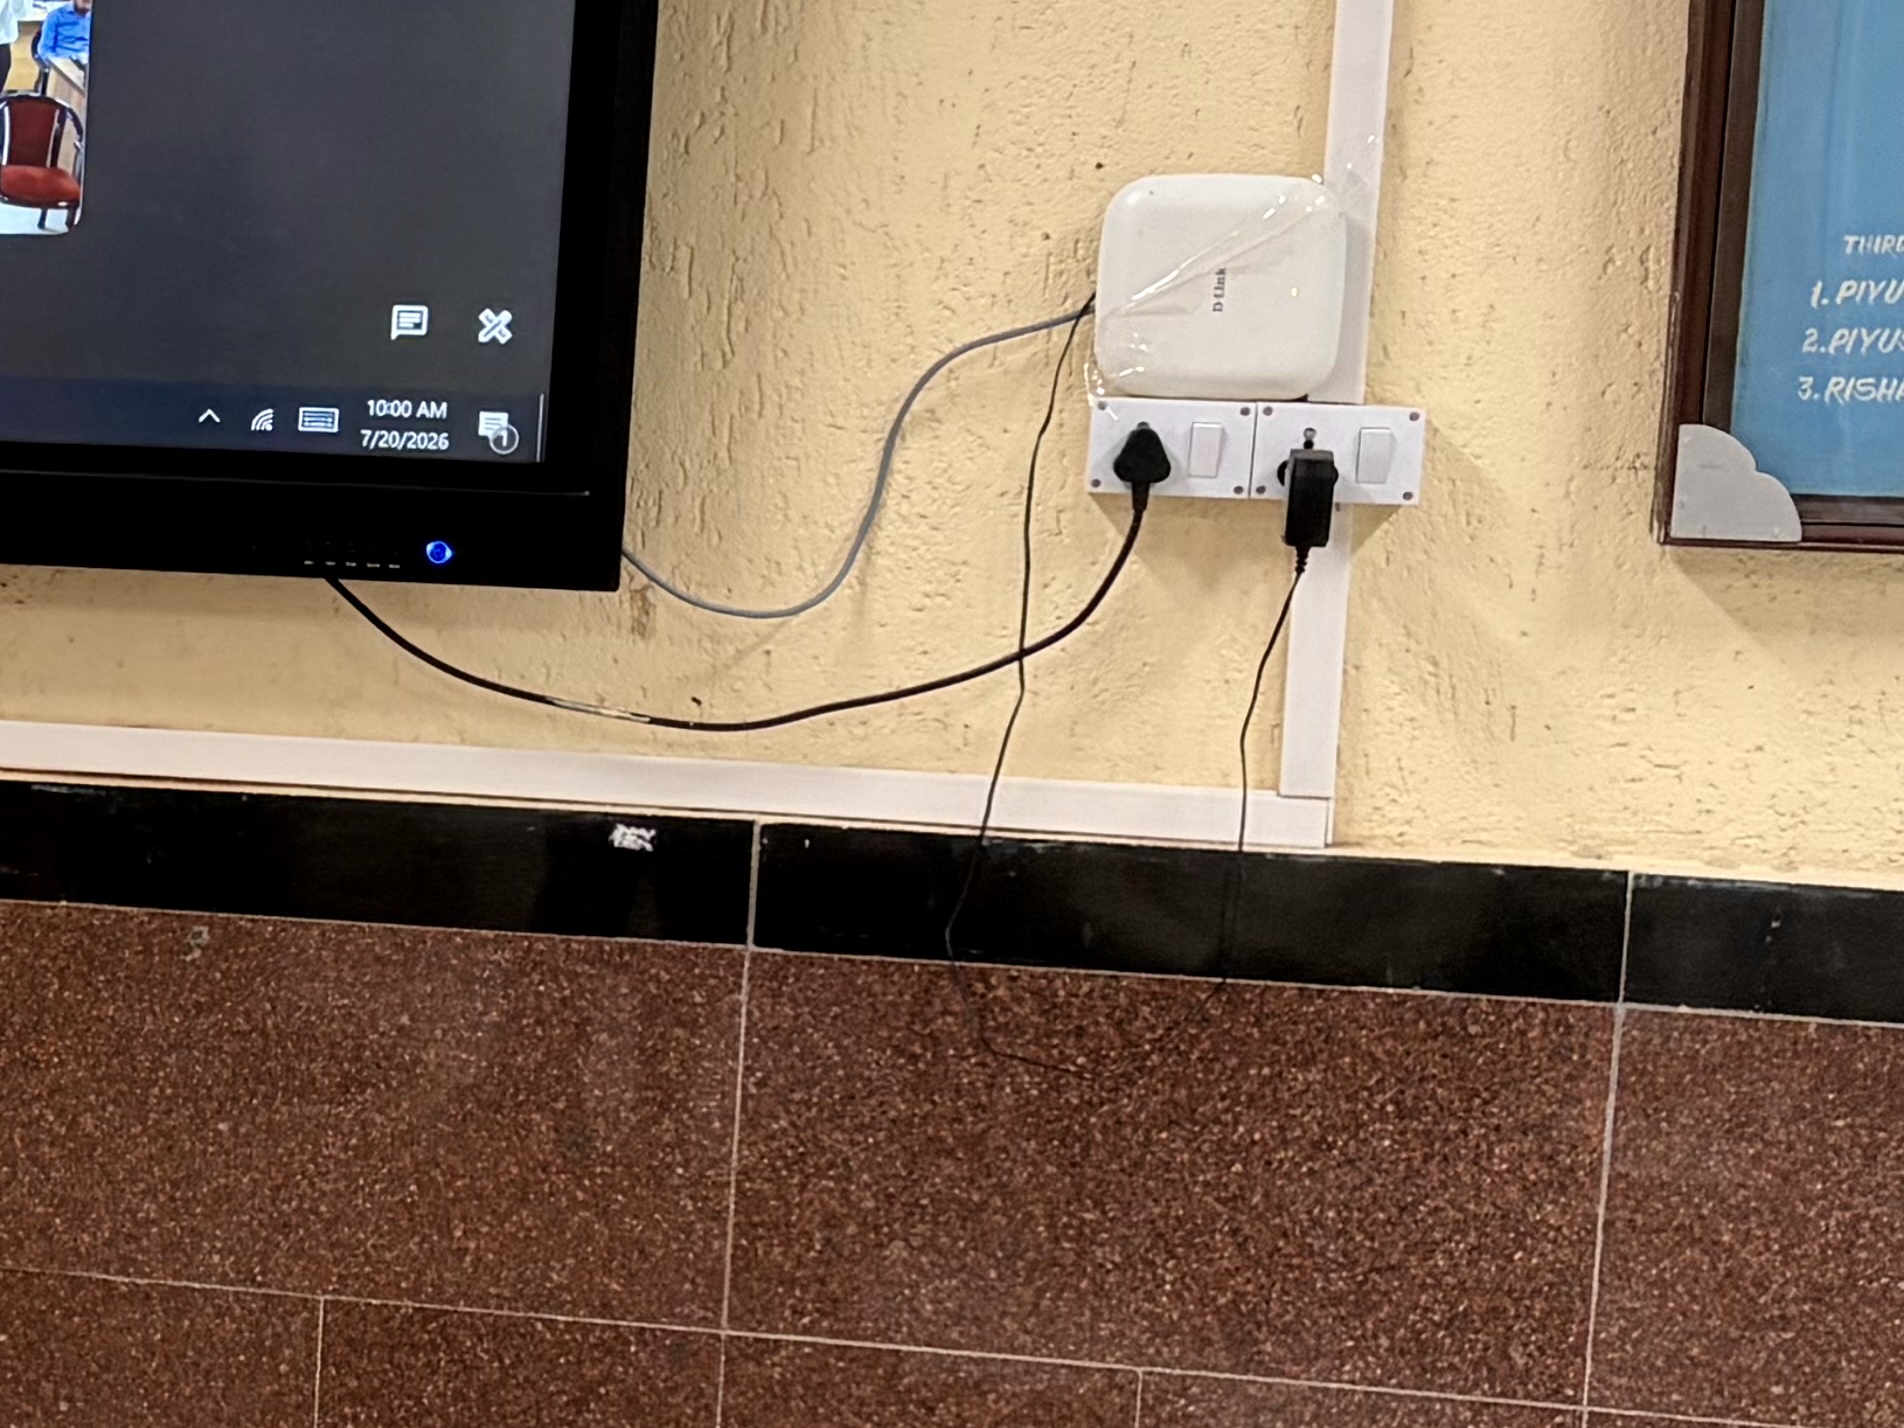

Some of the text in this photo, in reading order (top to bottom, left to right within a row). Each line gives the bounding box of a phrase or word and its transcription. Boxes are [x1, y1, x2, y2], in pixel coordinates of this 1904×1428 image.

[1810, 280, 1829, 309] 1.
[1802, 328, 1826, 353] 2.
[1797, 376, 1820, 401] 3.
[367, 399, 447, 419] 10:00 AM
[360, 430, 449, 450] 7/20/2026
